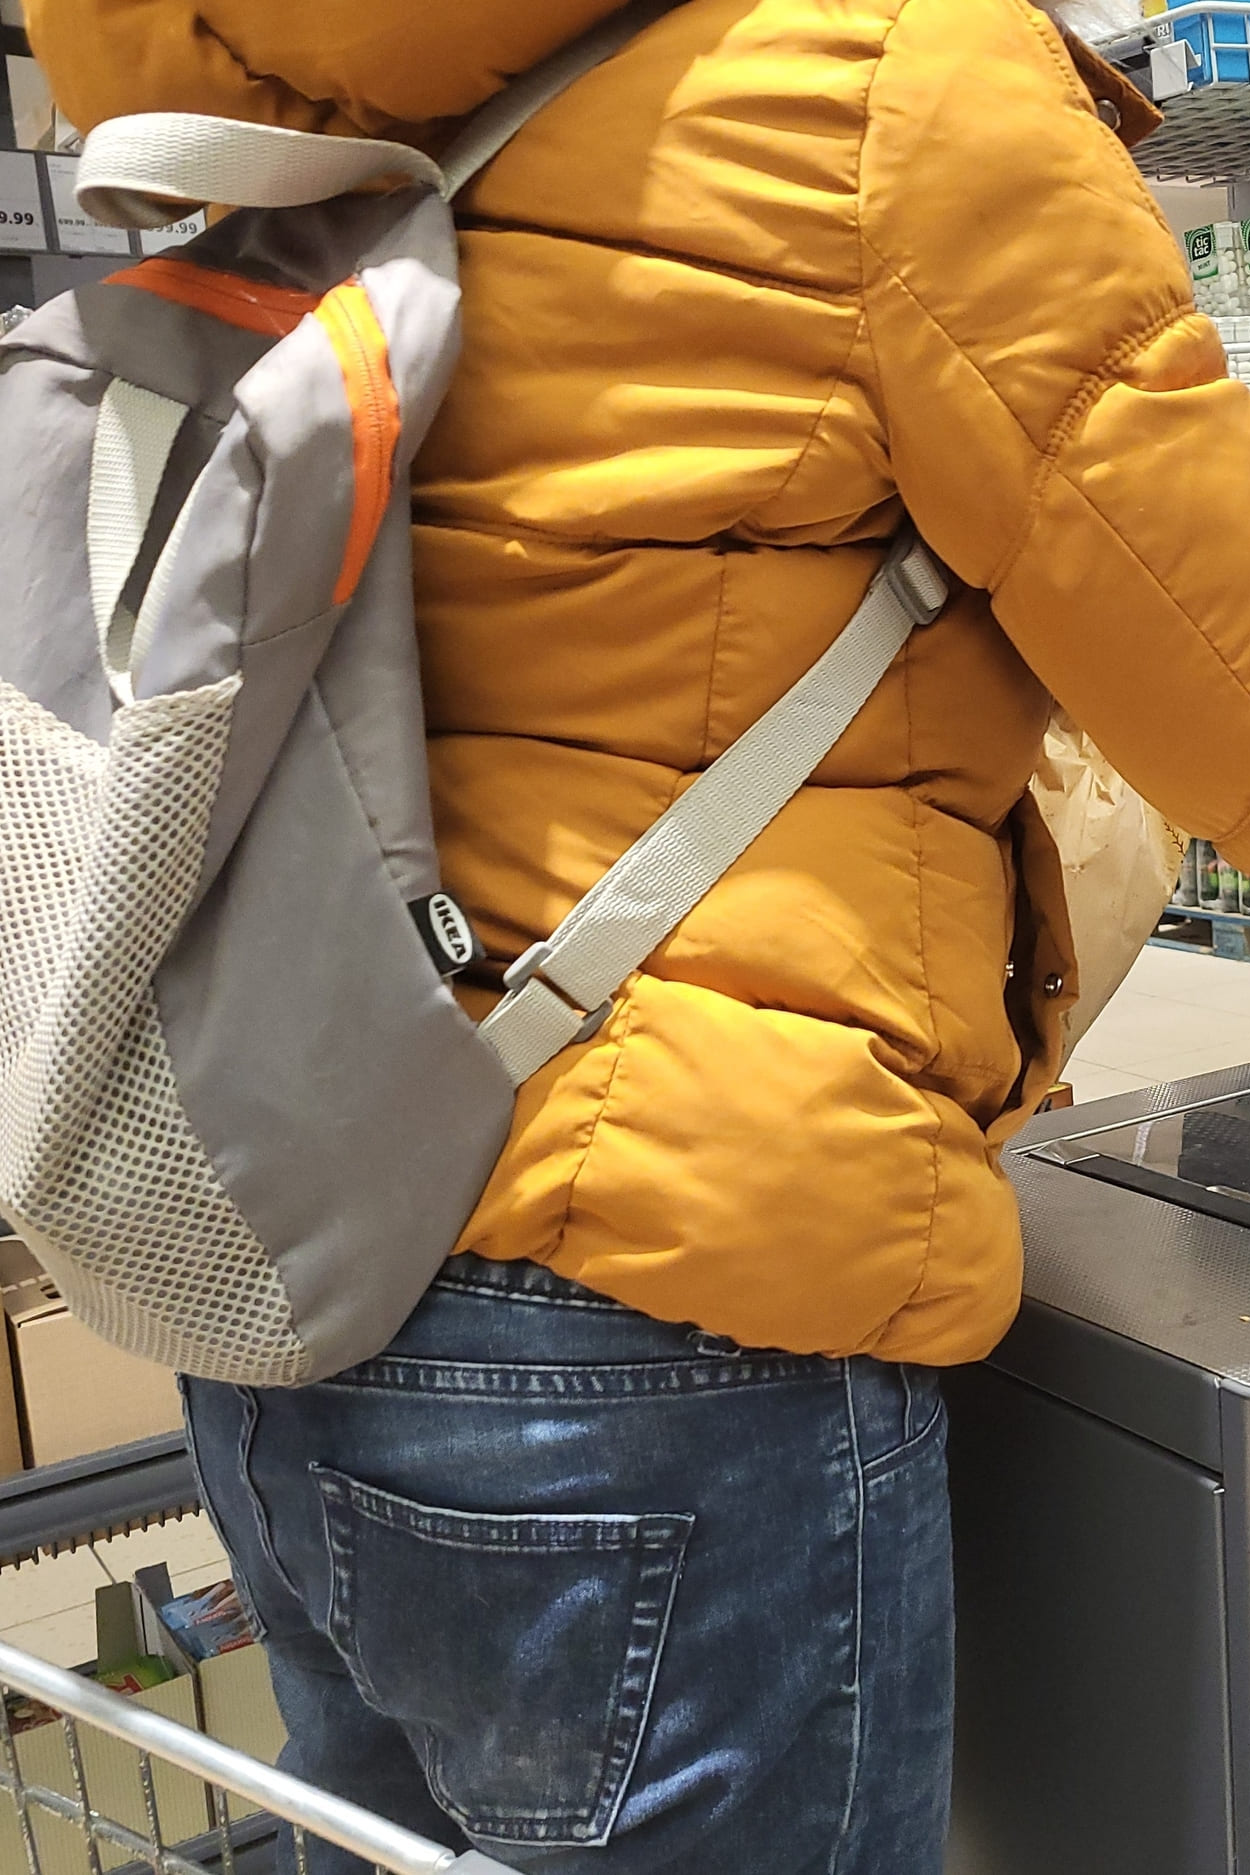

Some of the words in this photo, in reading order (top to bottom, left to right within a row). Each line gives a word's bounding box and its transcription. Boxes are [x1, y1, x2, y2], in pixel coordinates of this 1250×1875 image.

[1195, 235, 1209, 247] tic
[1193, 245, 1209, 257] tac
[433, 899, 467, 960] IKEA
